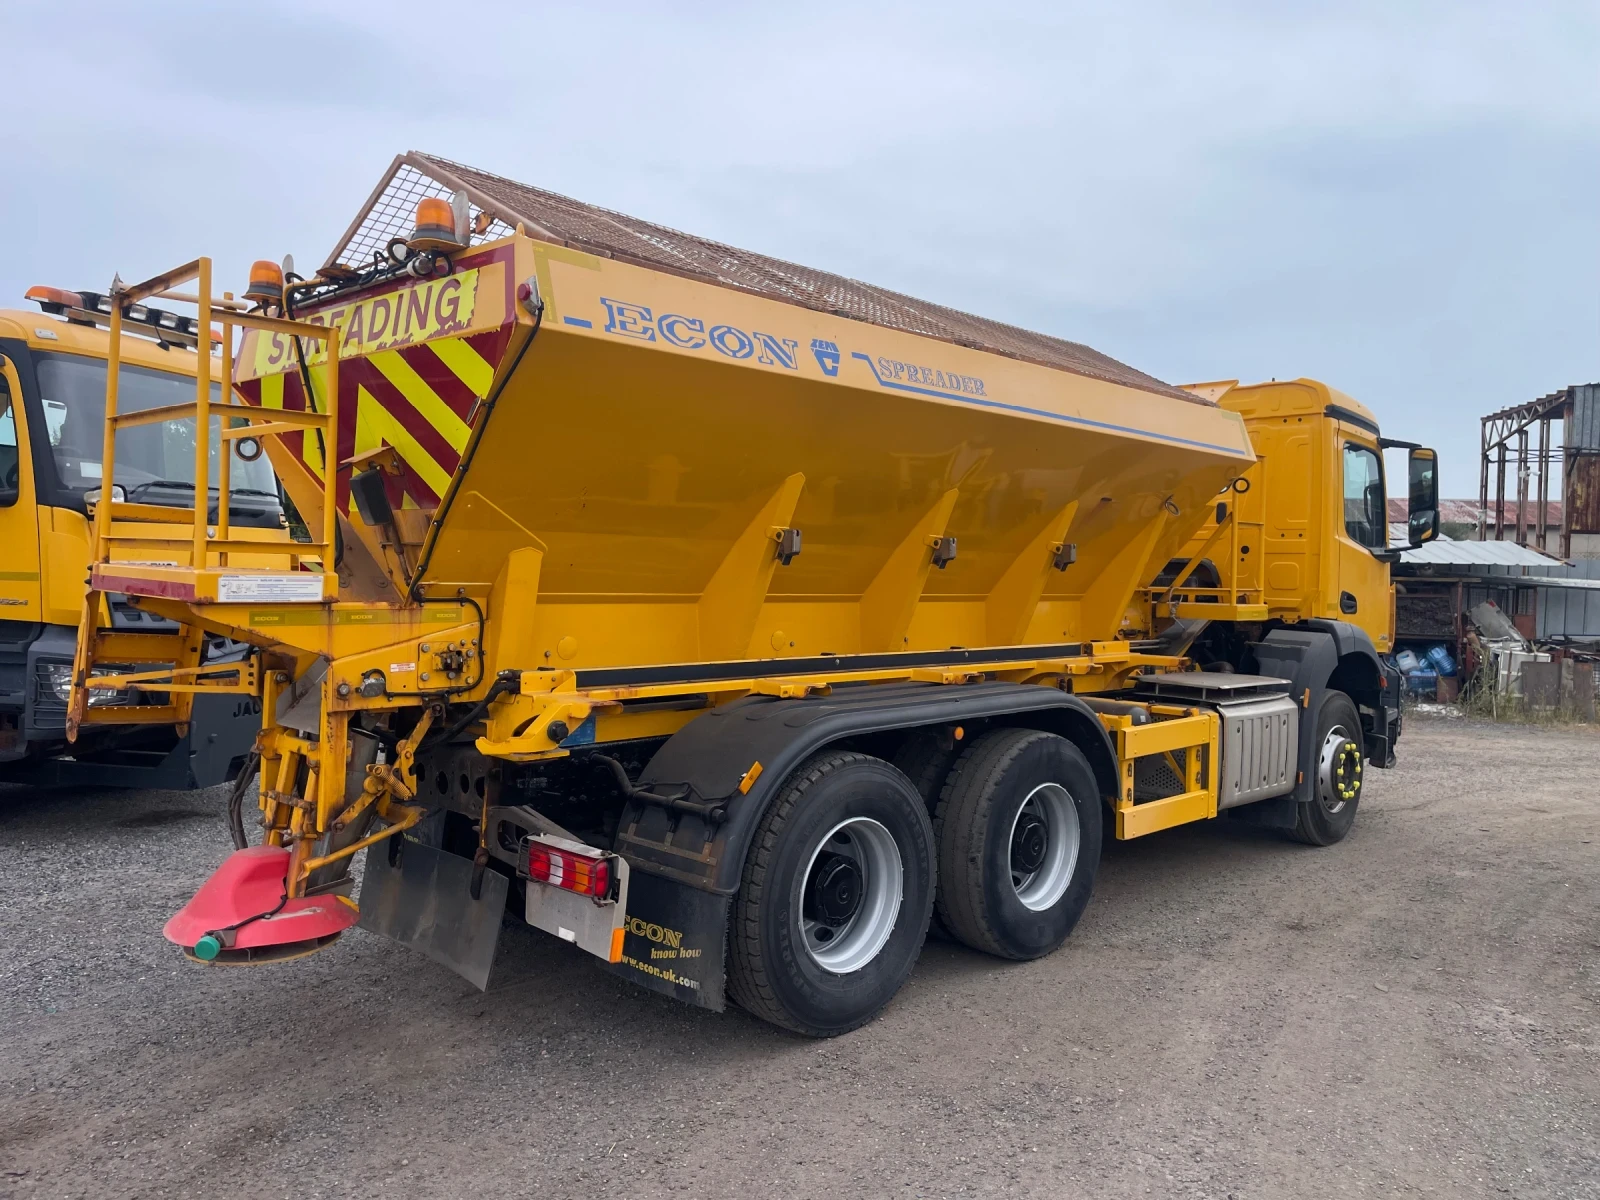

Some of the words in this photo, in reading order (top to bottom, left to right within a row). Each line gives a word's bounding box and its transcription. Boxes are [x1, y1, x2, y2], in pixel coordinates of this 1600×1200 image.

[268, 278, 461, 365] SREADING
[600, 297, 798, 370] ECON
[878, 356, 987, 396] SPREADER
[651, 947, 677, 959] know
[679, 946, 702, 958] how
